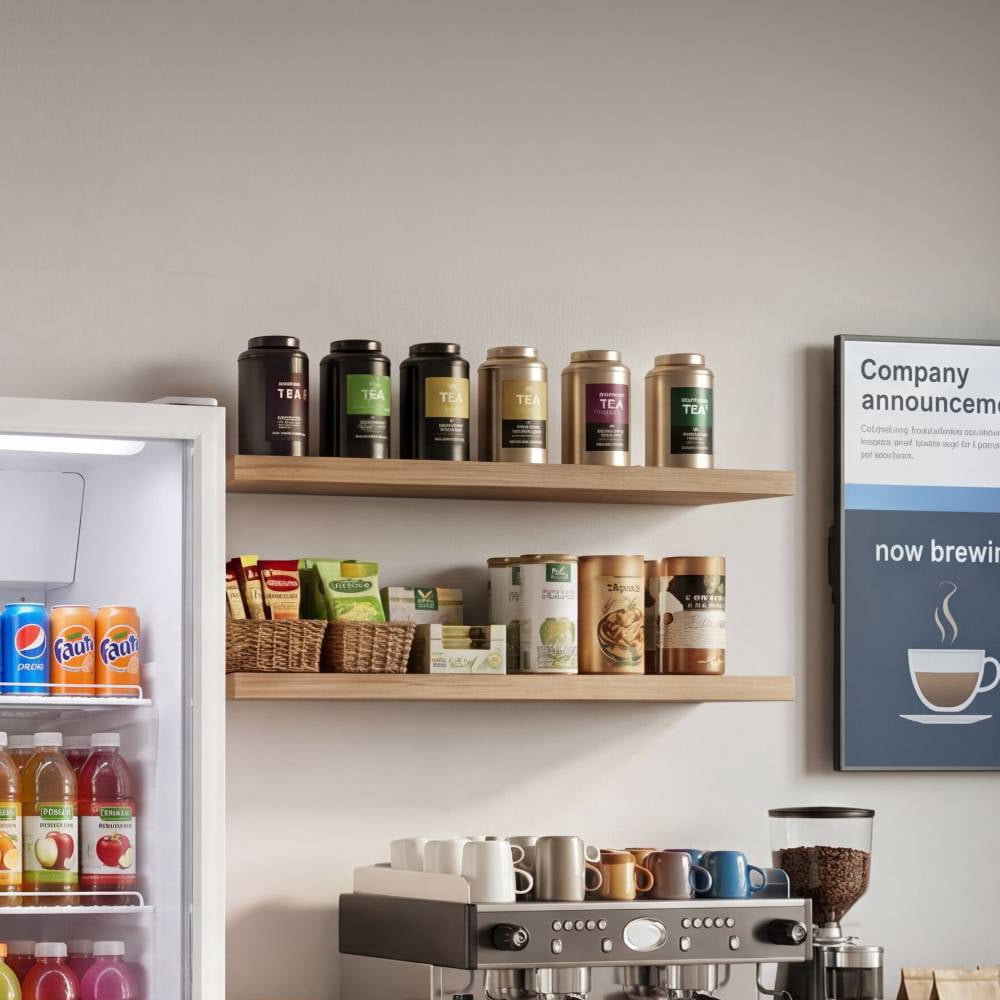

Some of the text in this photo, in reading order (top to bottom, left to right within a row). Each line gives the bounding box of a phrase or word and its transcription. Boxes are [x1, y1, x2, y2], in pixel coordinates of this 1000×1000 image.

[861, 358, 969, 389] Company
[360, 388, 385, 401] TEA
[439, 391, 463, 403] TEA
[515, 394, 540, 405] TEA
[600, 398, 624, 410] TEA
[862, 392, 1000, 415] announcem
[875, 543, 924, 562] now
